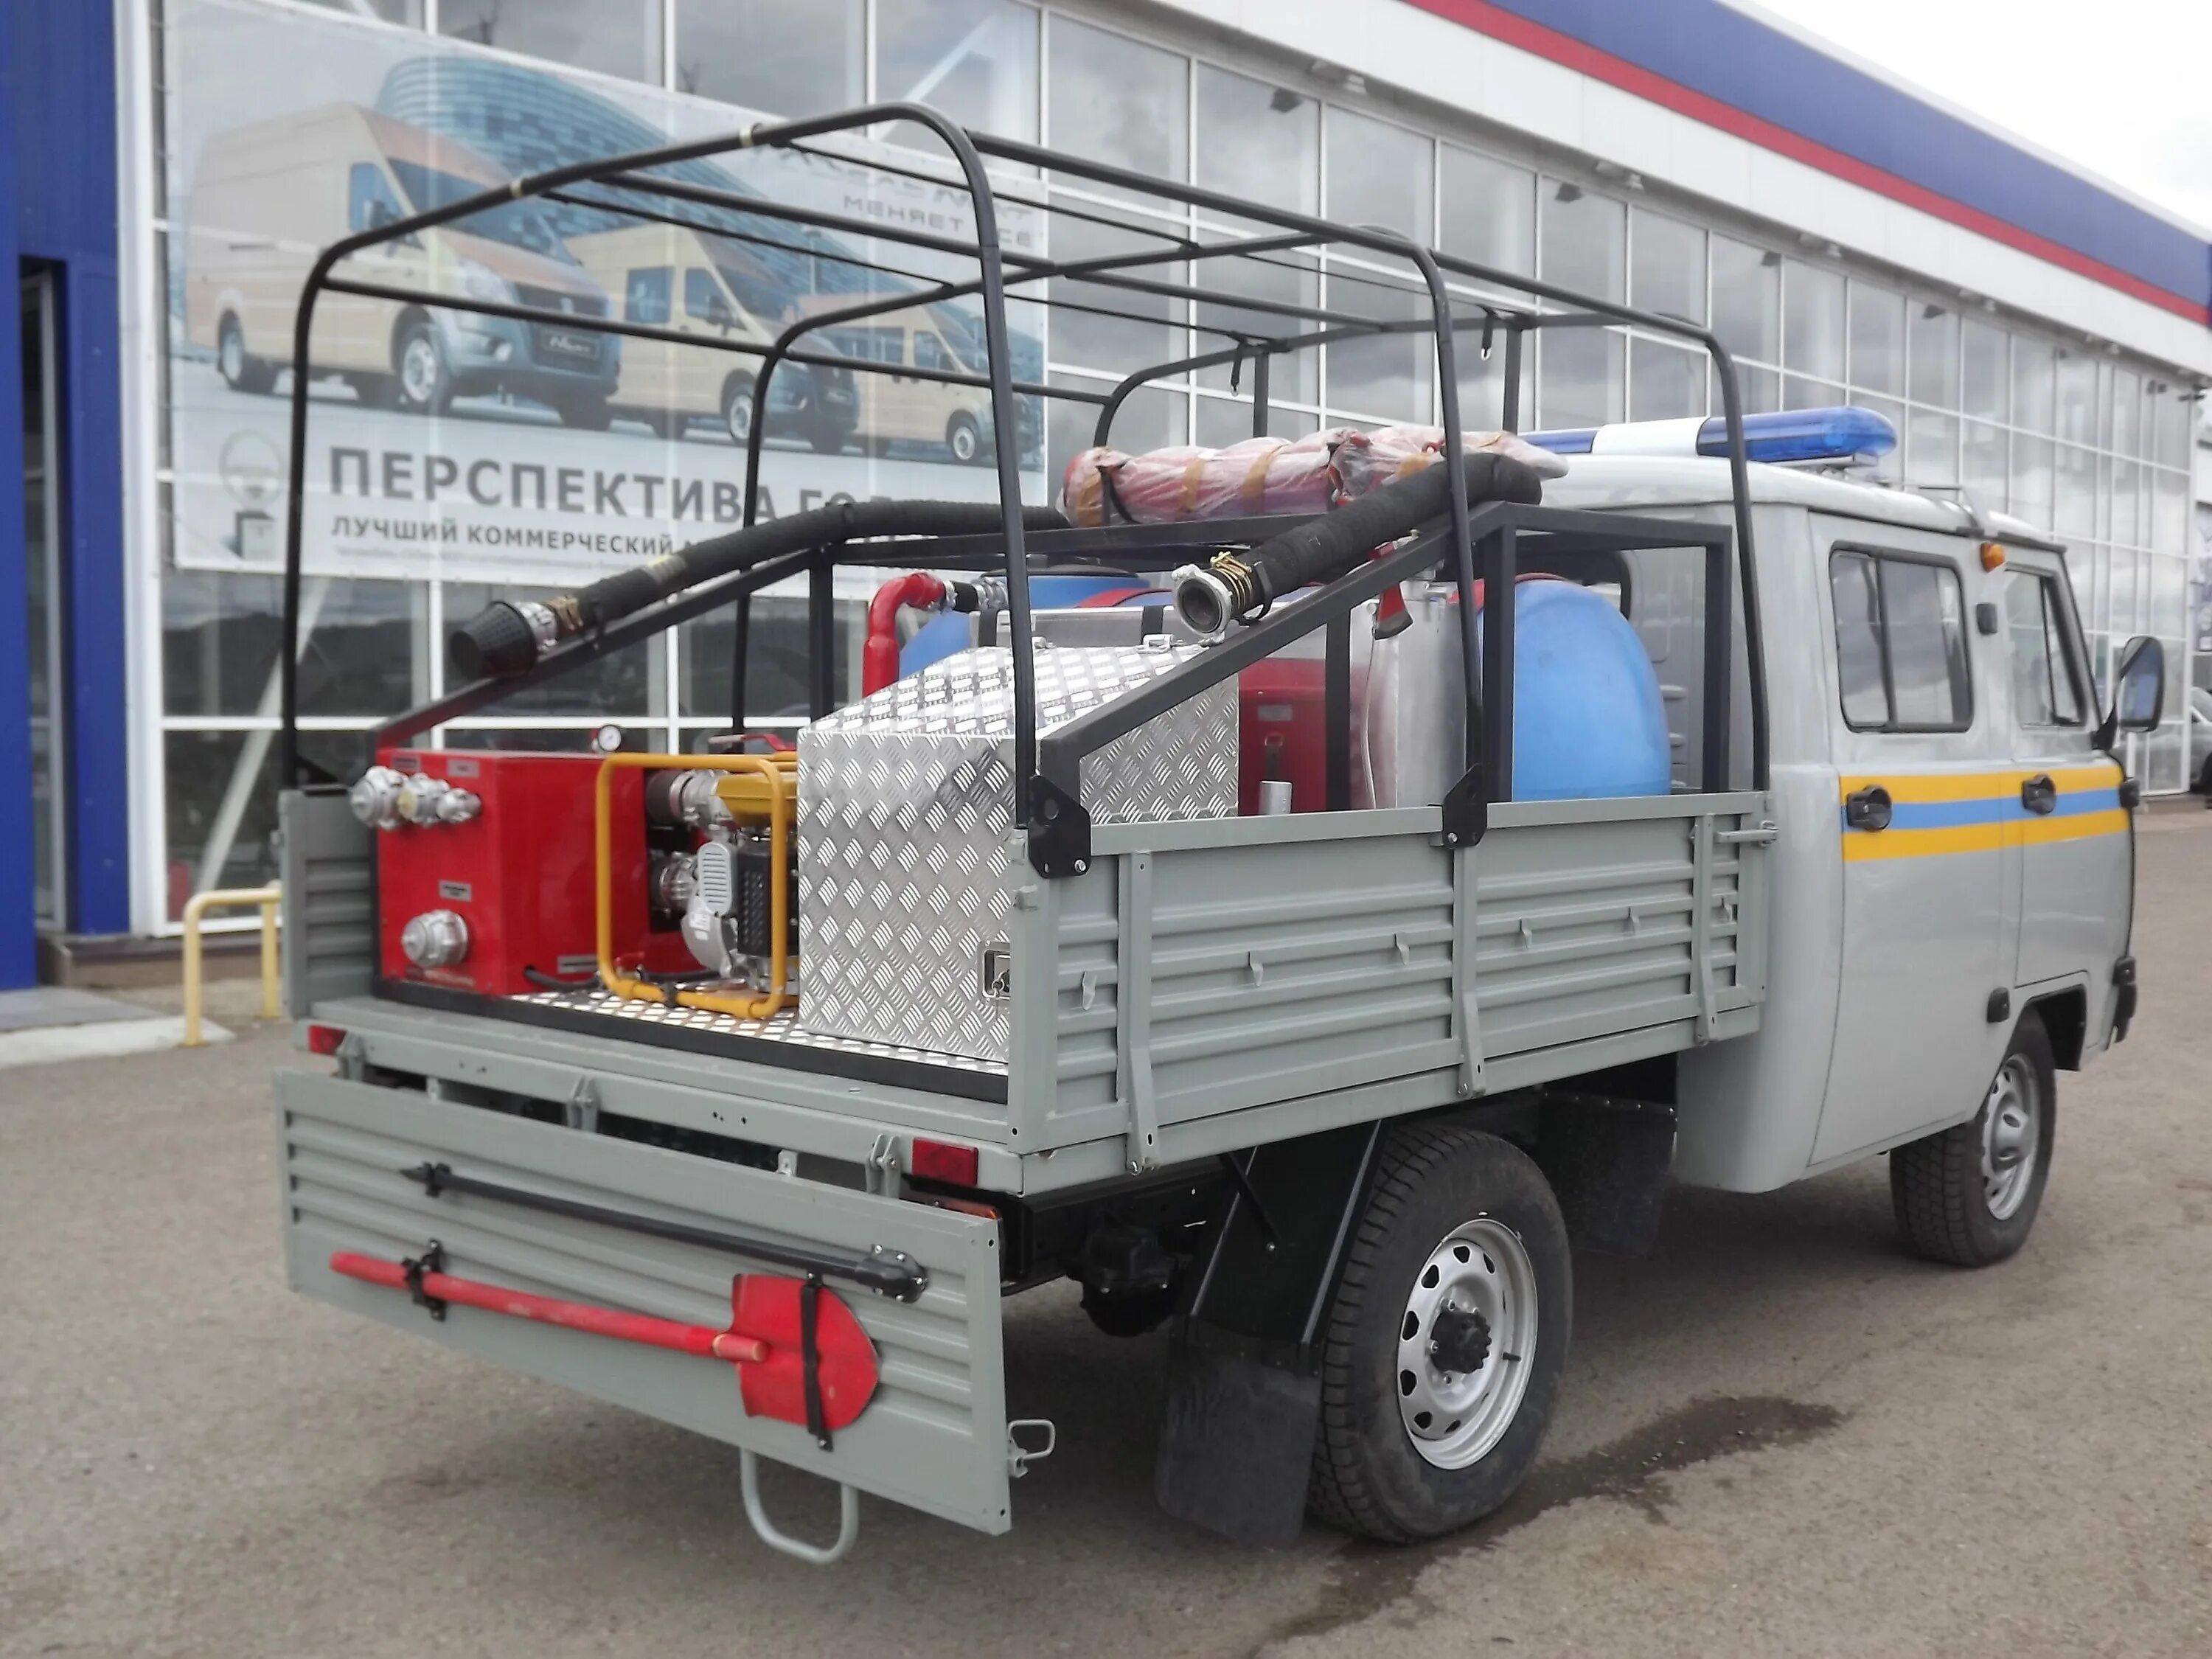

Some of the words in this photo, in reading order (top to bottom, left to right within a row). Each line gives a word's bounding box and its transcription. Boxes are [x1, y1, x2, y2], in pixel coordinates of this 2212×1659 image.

[843, 193, 964, 233] МЕНЯЕТ
[330, 445, 779, 524] ПЕРСПЕКТИВА
[330, 515, 458, 543] ЛУЧШИЙ
[467, 524, 672, 556] КОММЕРЧЕСКИЙ
